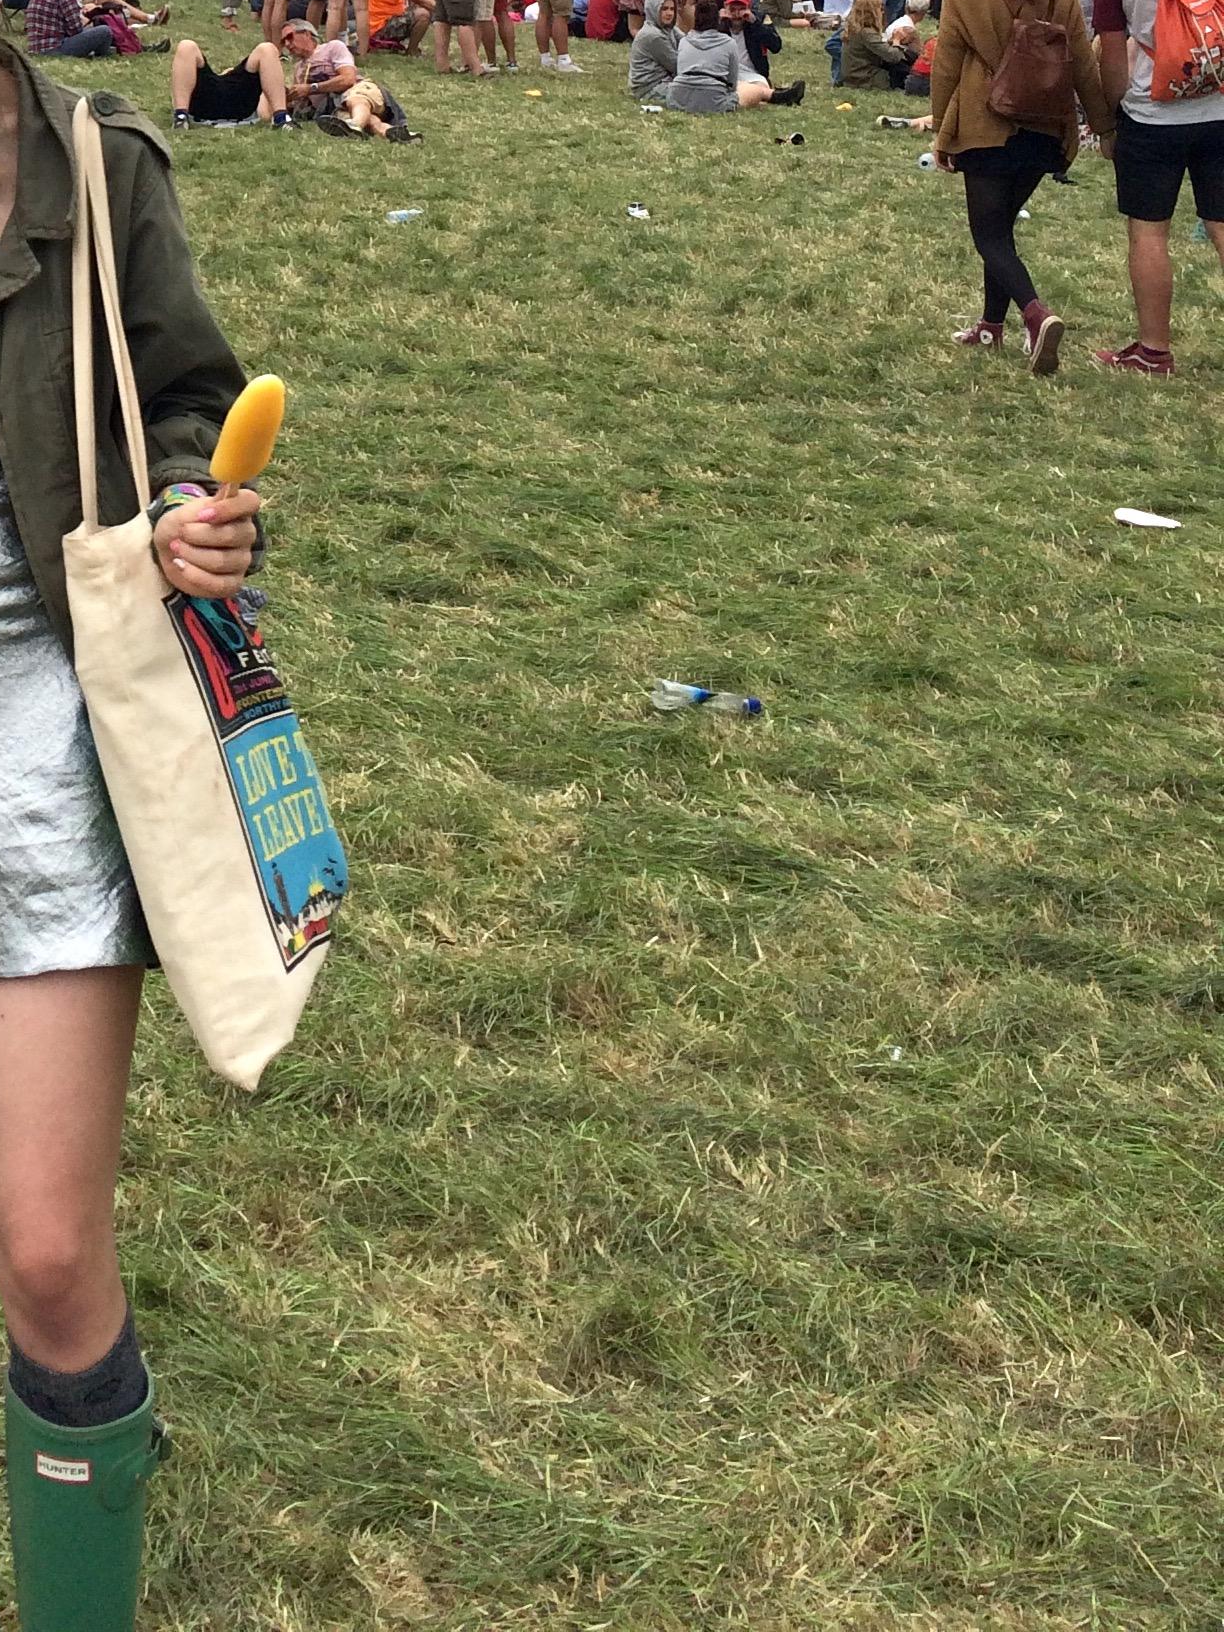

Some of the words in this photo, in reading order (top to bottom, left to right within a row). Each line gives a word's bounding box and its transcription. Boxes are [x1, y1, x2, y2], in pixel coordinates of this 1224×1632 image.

[235, 734, 298, 806] LOVE
[252, 787, 325, 862] LEAVE
[39, 1461, 86, 1476] HUNTER
